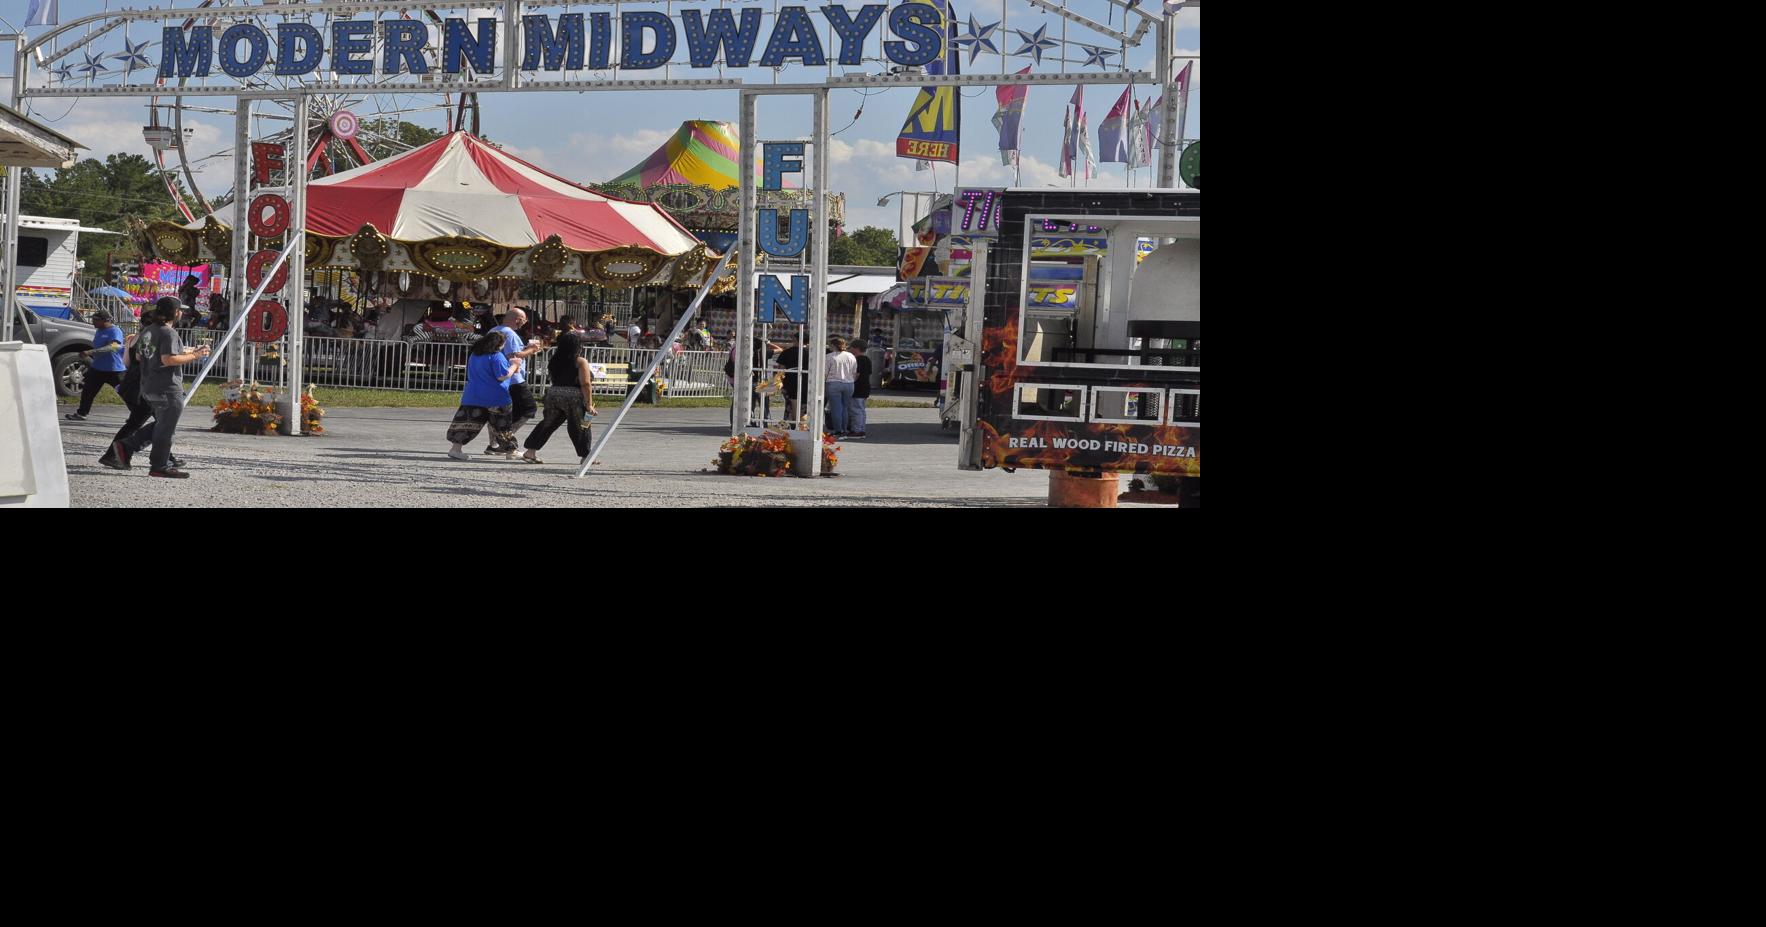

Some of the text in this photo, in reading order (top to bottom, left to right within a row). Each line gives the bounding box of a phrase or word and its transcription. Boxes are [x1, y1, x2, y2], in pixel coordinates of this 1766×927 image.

[159, 3, 943, 78] MODERN MIDWAYS
[245, 142, 291, 343] FOOD
[757, 143, 809, 325] FUN
[1009, 437, 1196, 458] REAL WOOD FIRED PIZZA
